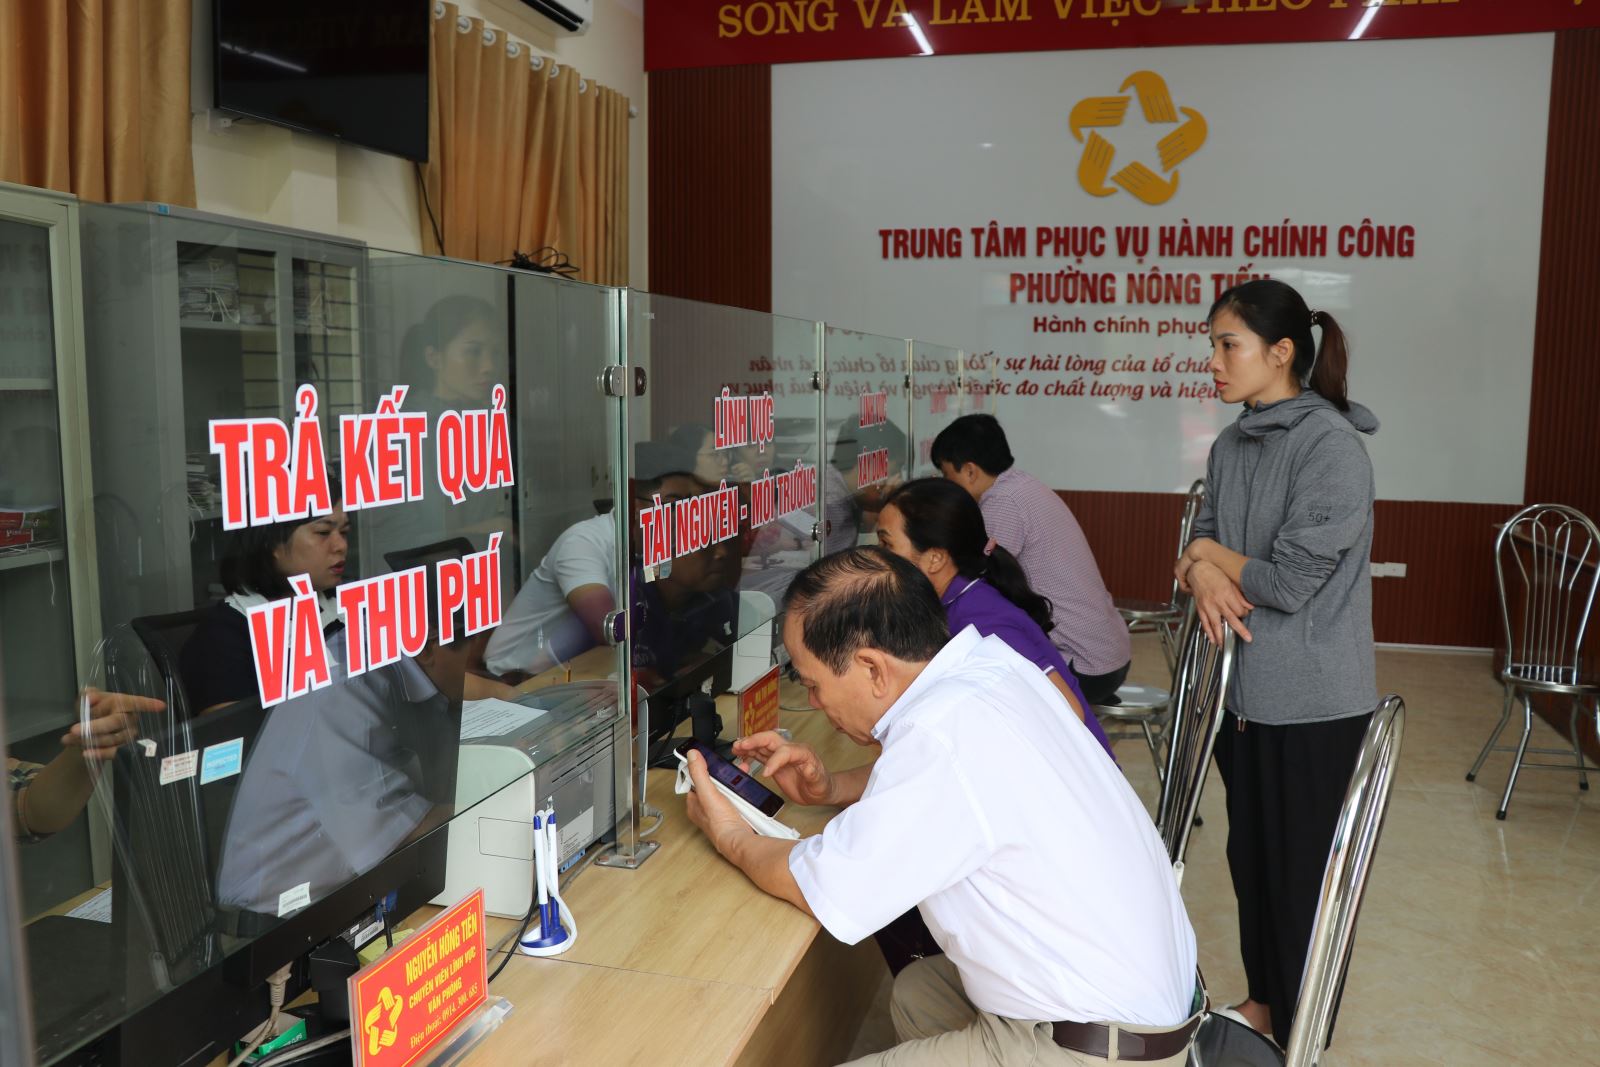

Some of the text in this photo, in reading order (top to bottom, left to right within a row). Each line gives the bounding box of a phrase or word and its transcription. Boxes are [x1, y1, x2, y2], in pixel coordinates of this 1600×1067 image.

[879, 218, 1415, 264] TRUNG TÂM PHỤC VỤ HÀNH CHÍNH CÔNG
[1010, 265, 1116, 304] PHƯỜNG
[1126, 266, 1201, 304] NÔNG
[1033, 315, 1210, 339] Hành chính phục
[1003, 355, 1026, 375] sự
[1029, 353, 1060, 372] hài
[1065, 353, 1106, 376] lòng
[1111, 353, 1146, 372] của
[1152, 352, 1174, 373] tổ
[1016, 379, 1038, 396] đo
[1044, 375, 1086, 396] chất
[1090, 380, 1143, 401] lượng
[1150, 381, 1172, 398] và
[1178, 382, 1219, 403] hiệu
[714, 386, 774, 453] LĨNH VỰC
[209, 383, 515, 531] TRẢ KẾT QUẢ
[640, 493, 672, 569] TÀI
[676, 478, 739, 558] NGUYÊN
[751, 469, 775, 529] MÔI
[776, 458, 816, 520] TRƯỜNG
[246, 531, 503, 709] VÀ THU PHÍ
[439, 924, 461, 961] HỒNG
[460, 907, 478, 943] TIẾN
